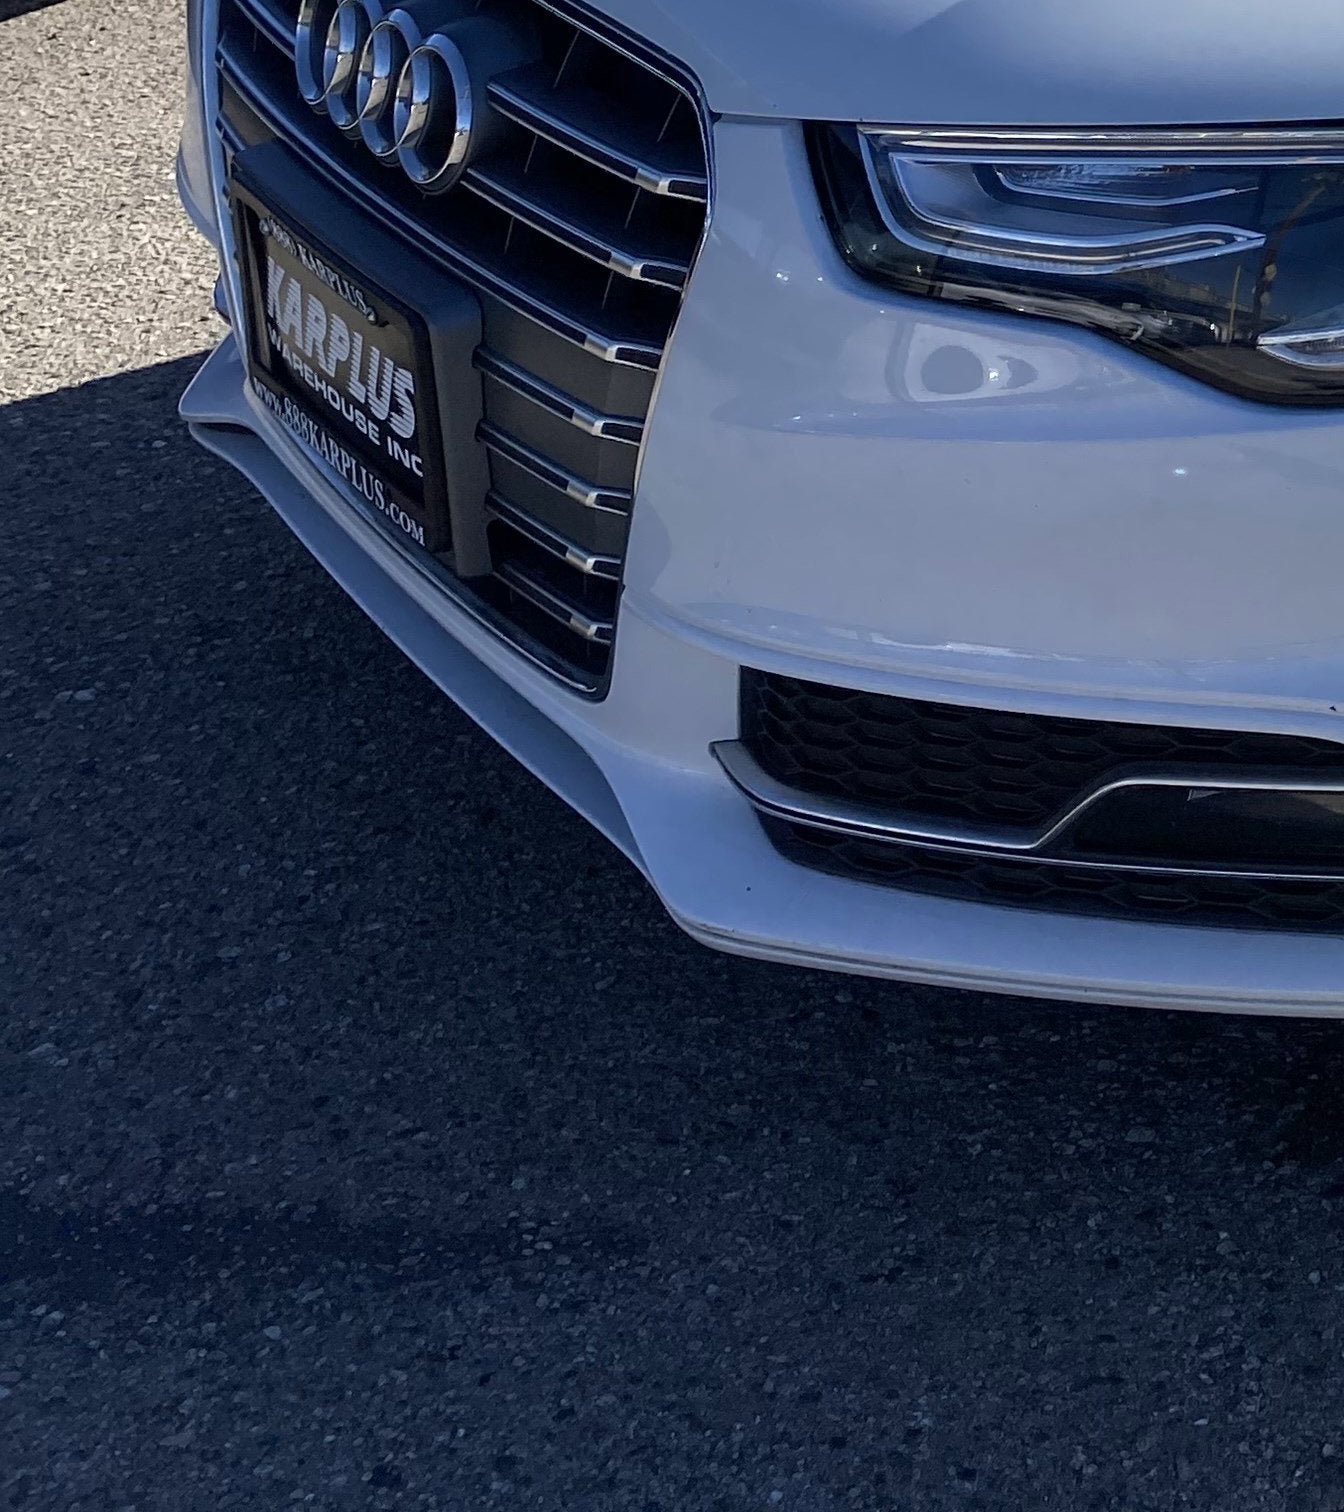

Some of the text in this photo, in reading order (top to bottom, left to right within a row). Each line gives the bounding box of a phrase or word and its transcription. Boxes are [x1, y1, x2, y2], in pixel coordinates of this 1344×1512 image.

[266, 255, 416, 439] KARPLUS
[296, 243, 368, 315] KARPLUS
[267, 321, 425, 479] WAREHOUSE INC
